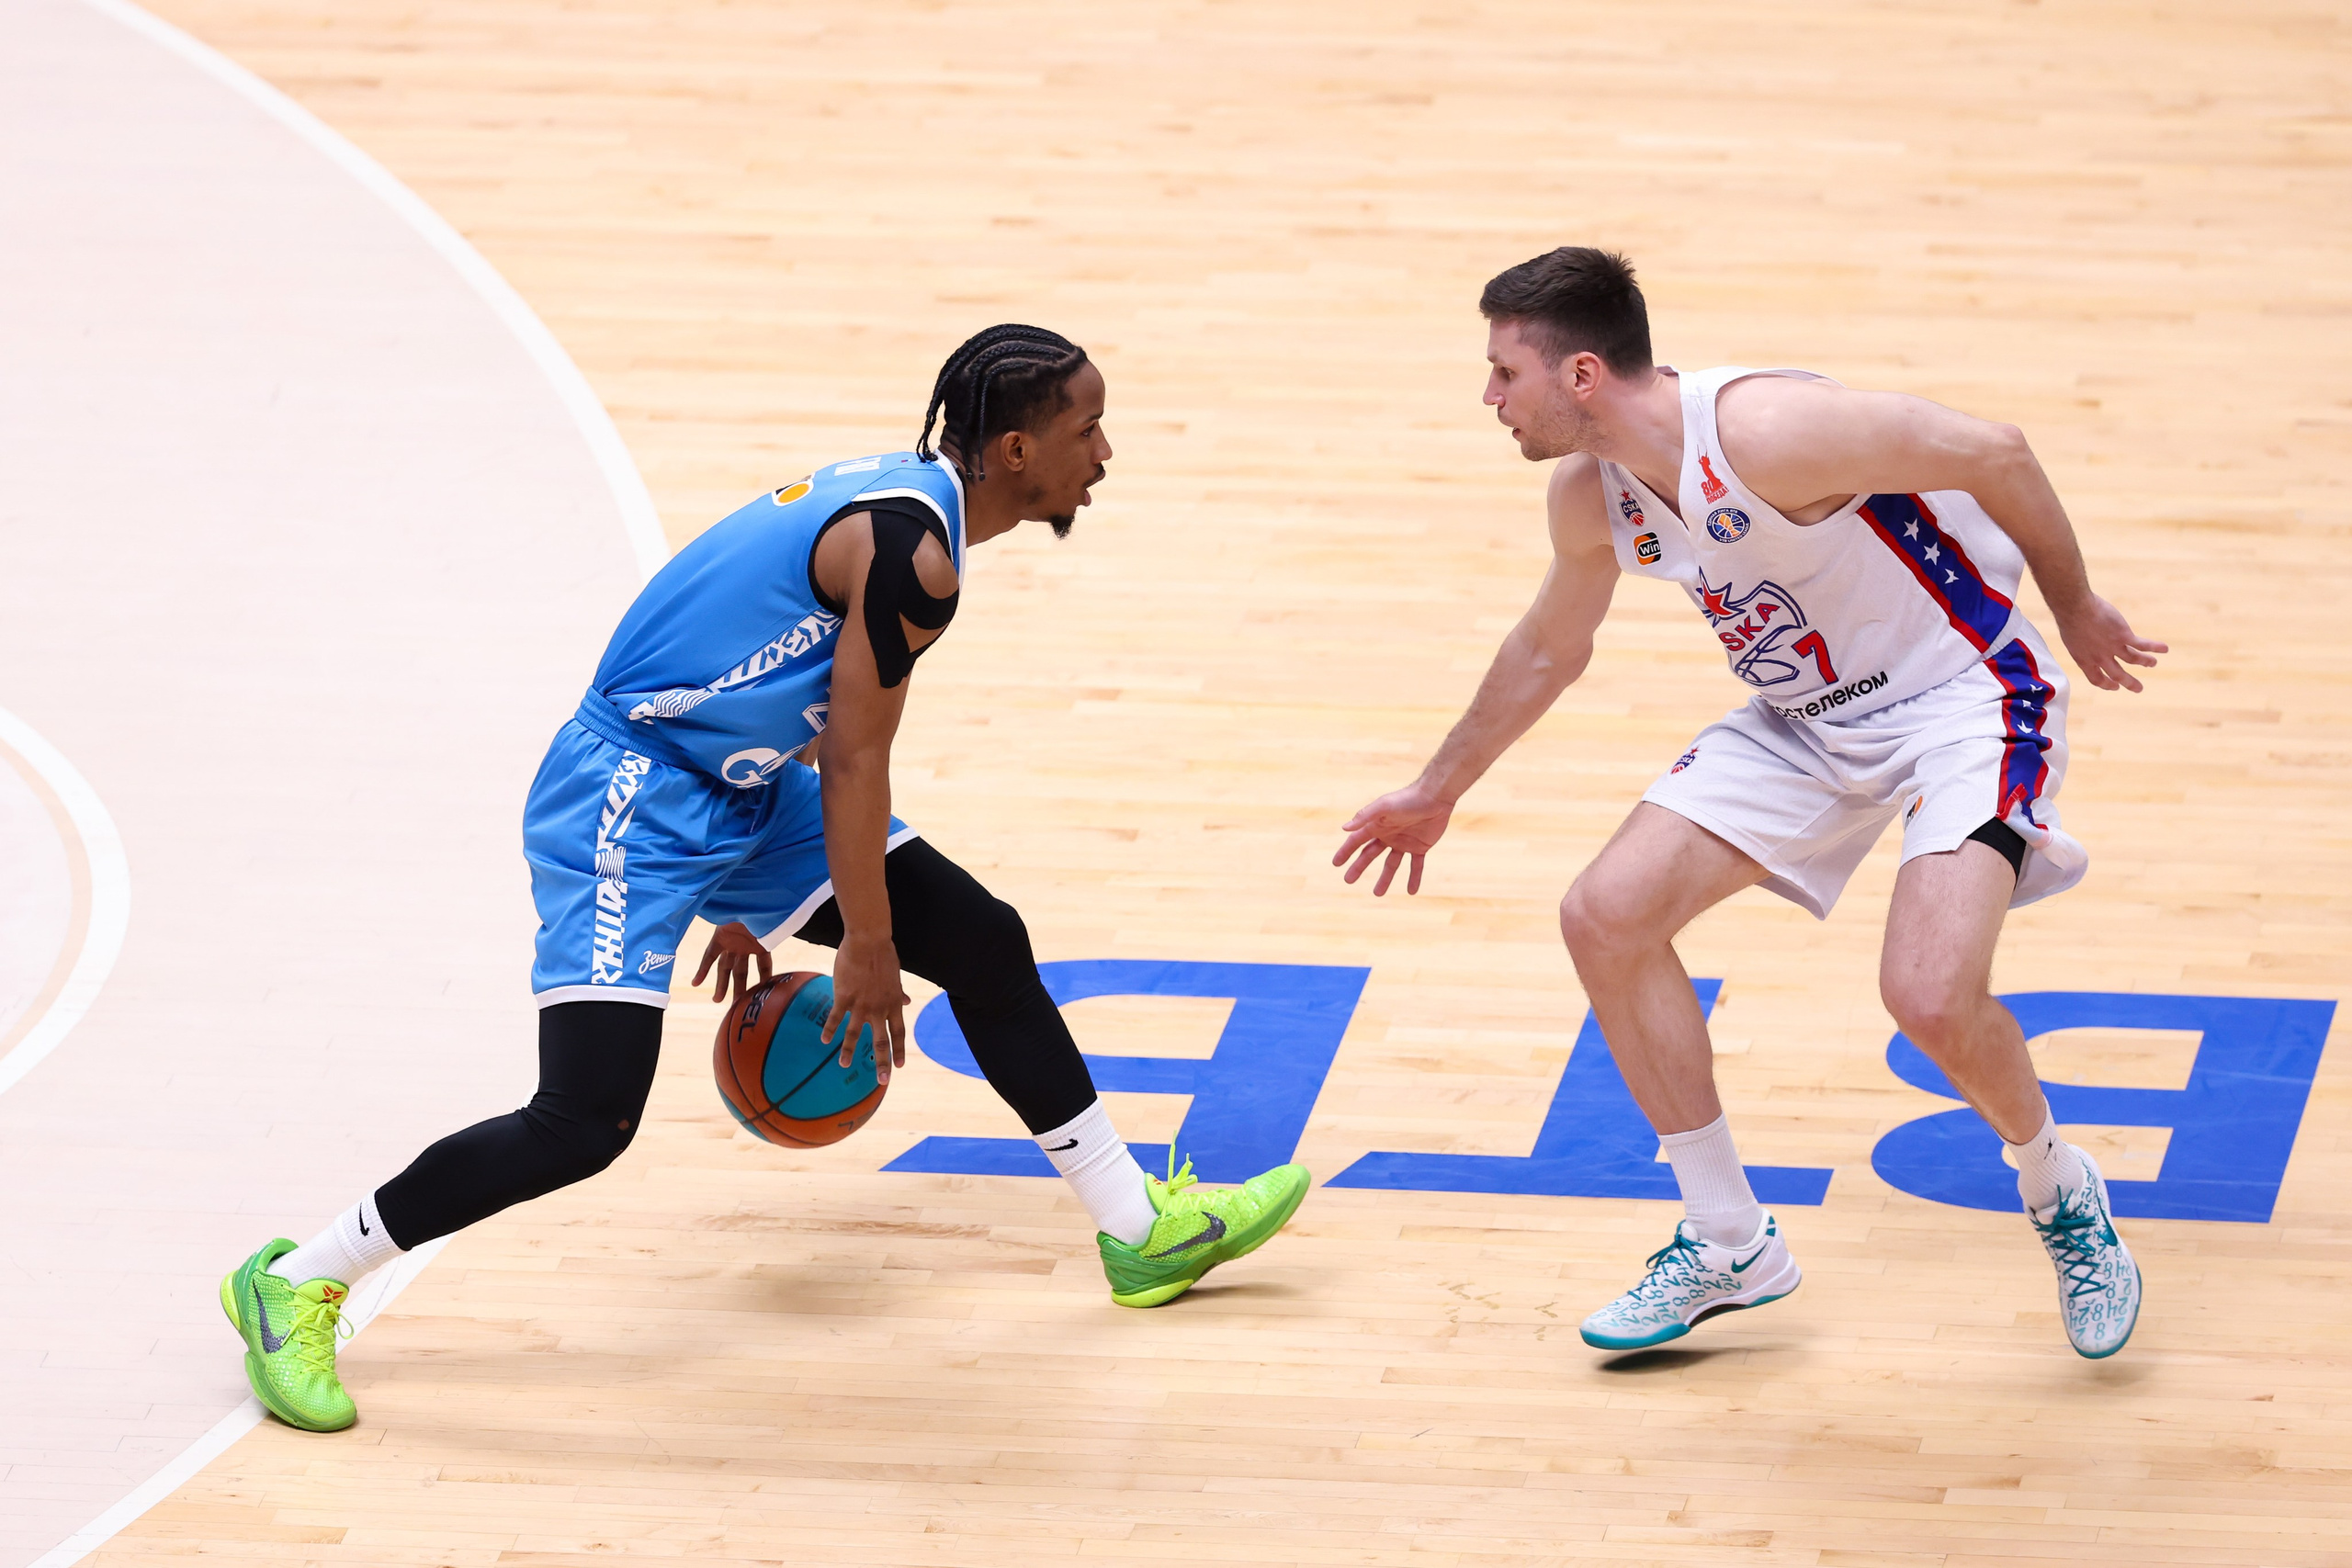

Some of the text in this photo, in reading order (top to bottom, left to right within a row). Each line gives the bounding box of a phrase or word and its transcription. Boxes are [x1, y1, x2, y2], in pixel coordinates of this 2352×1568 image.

[1706, 486, 1730, 505] ПОБЕДА!
[1639, 543, 1660, 556] Win
[1718, 603, 1781, 652] SKA
[1791, 629, 1839, 685] 7
[1772, 671, 1890, 719] остелеком
